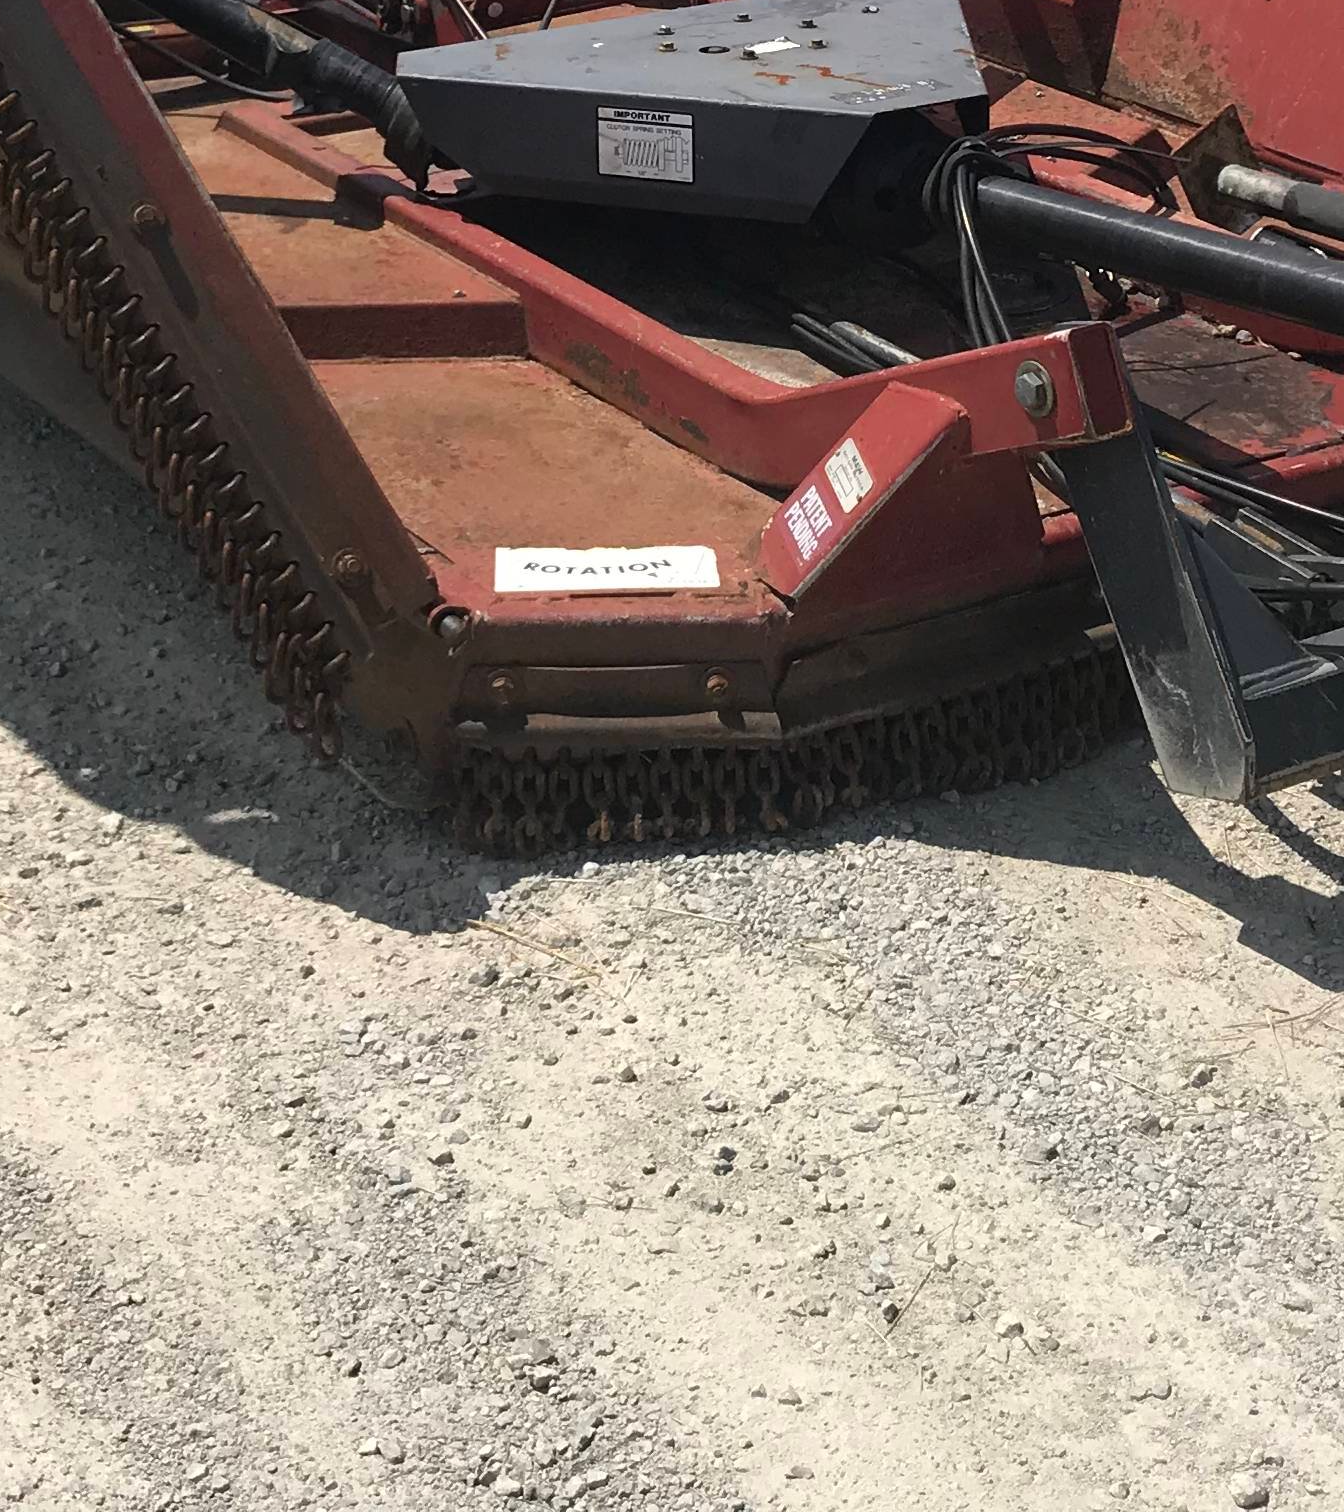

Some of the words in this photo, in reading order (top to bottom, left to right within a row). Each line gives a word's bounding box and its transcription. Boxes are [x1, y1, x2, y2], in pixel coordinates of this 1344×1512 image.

[613, 110, 671, 122] IMPORTANT
[801, 485, 833, 538] PATENT
[784, 501, 819, 561] PENDING
[523, 559, 672, 576] ROTATION
